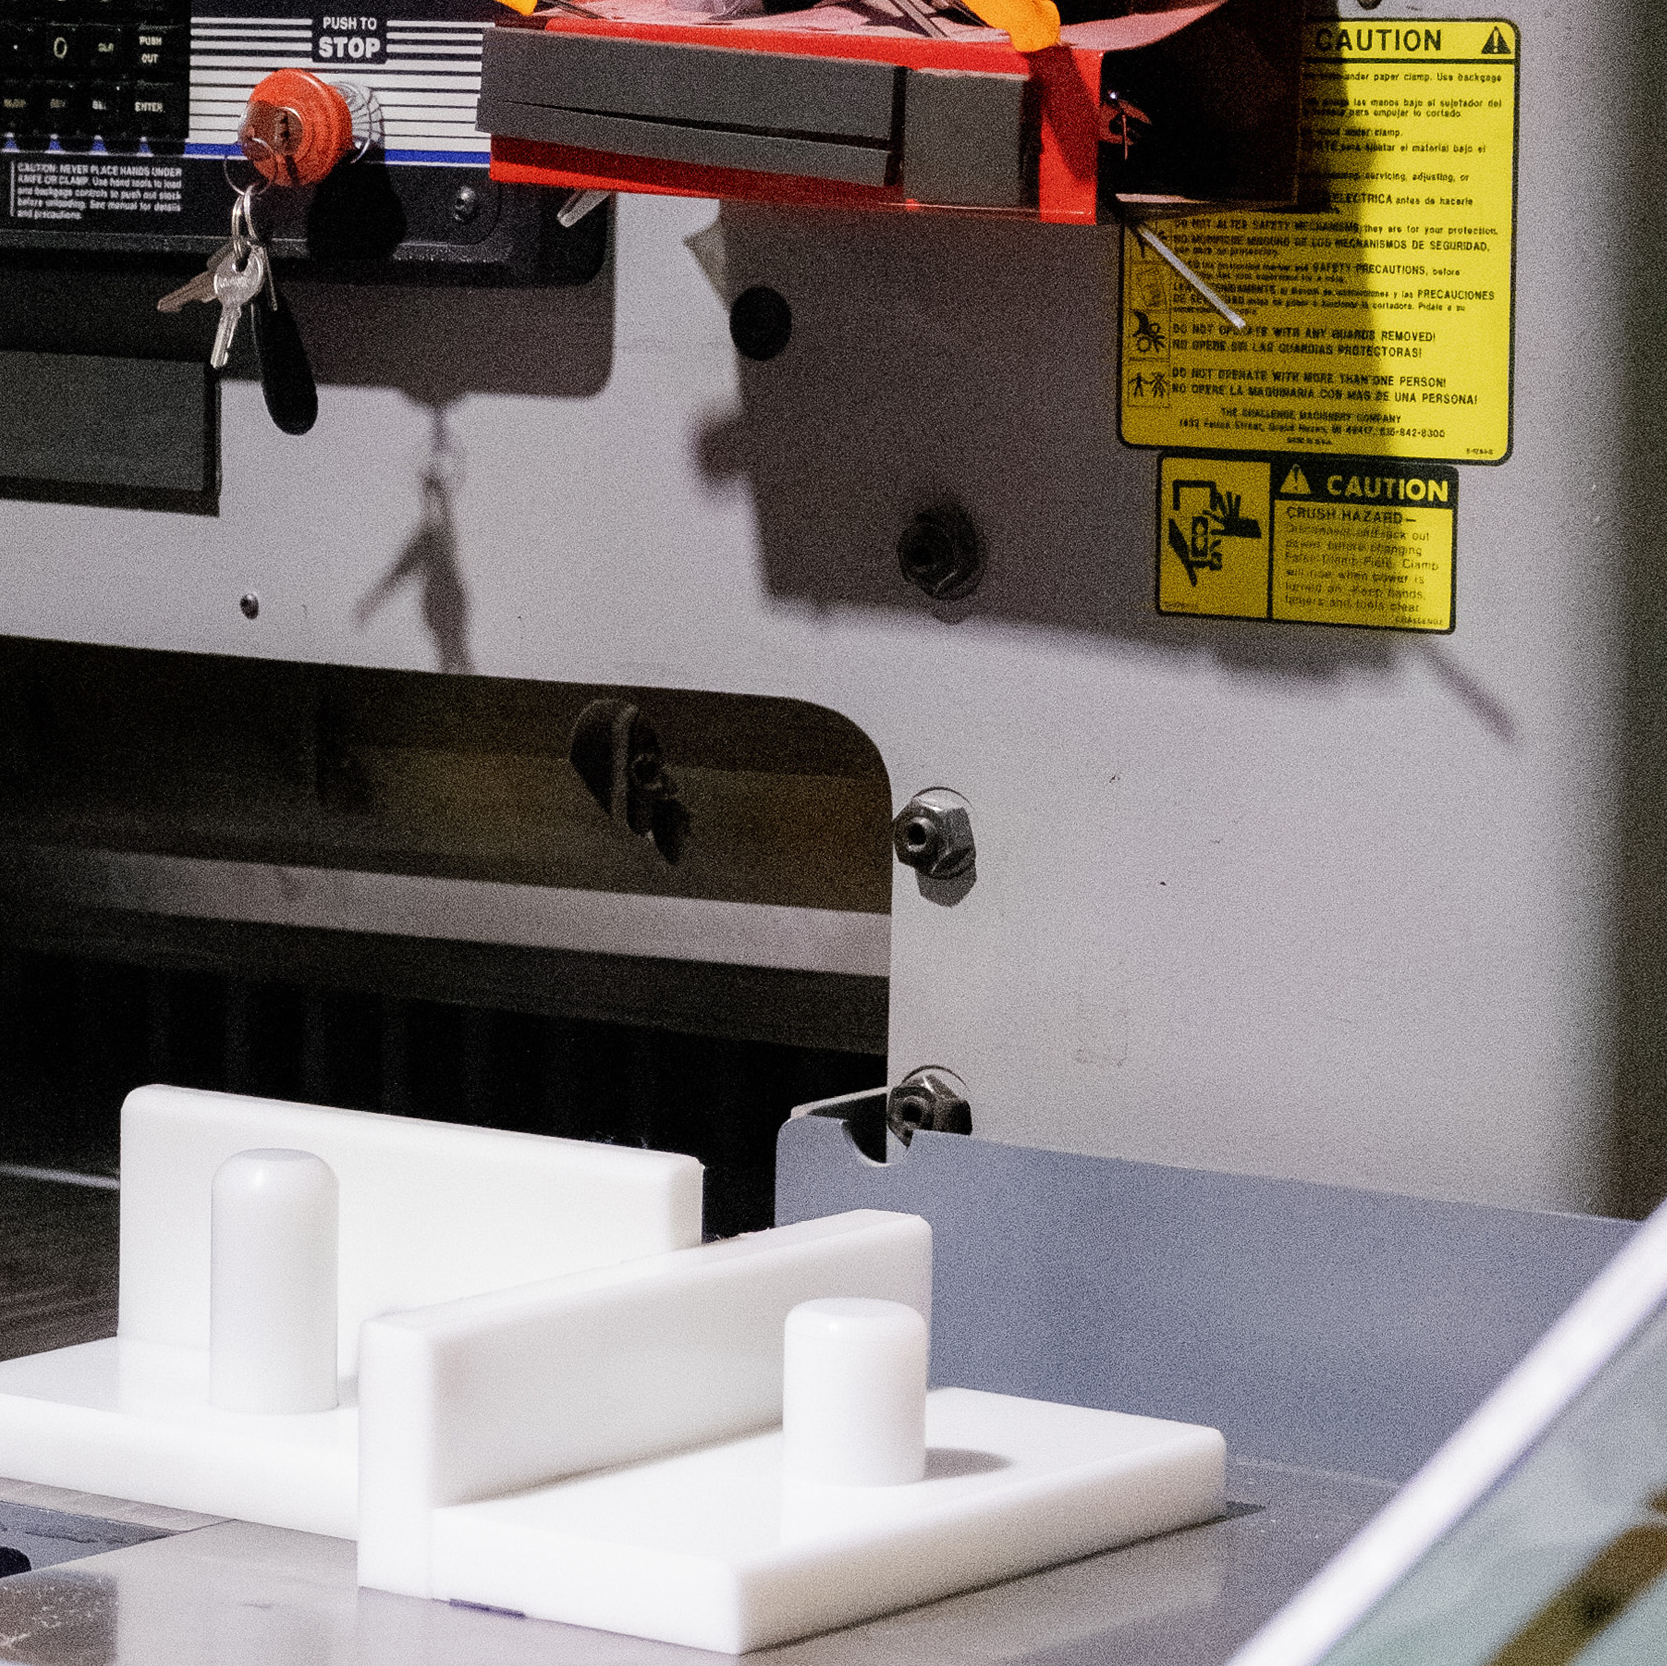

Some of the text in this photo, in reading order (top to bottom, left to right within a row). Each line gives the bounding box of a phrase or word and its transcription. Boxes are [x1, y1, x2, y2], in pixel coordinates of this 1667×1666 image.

[323, 17, 378, 31] PUSH TO
[53, 36, 69, 59] 0
[318, 36, 381, 58] STOP
[1317, 28, 1442, 52] CAUTION
[1373, 73, 1399, 84] paper
[1437, 72, 1453, 82] Use
[59, 164, 89, 175] NEVER
[90, 165, 119, 176] PLACE
[152, 166, 182, 178] UNDER
[1411, 239, 1425, 250] DE
[1417, 288, 1496, 301] PRECAUCIONES
[1381, 330, 1436, 343] REMOVED!
[1338, 344, 1423, 359] PROTECTORAS!
[1191, 367, 1213, 379] NOT
[1271, 370, 1299, 382] WITH
[1372, 375, 1395, 387] ONE
[1399, 376, 1447, 389] PERSON!
[1320, 388, 1343, 400] CON
[1394, 391, 1417, 403] UNA
[1421, 393, 1479, 406] PERSONA!
[1326, 474, 1450, 503] CAUTION
[1286, 506, 1336, 521] CRUSH
